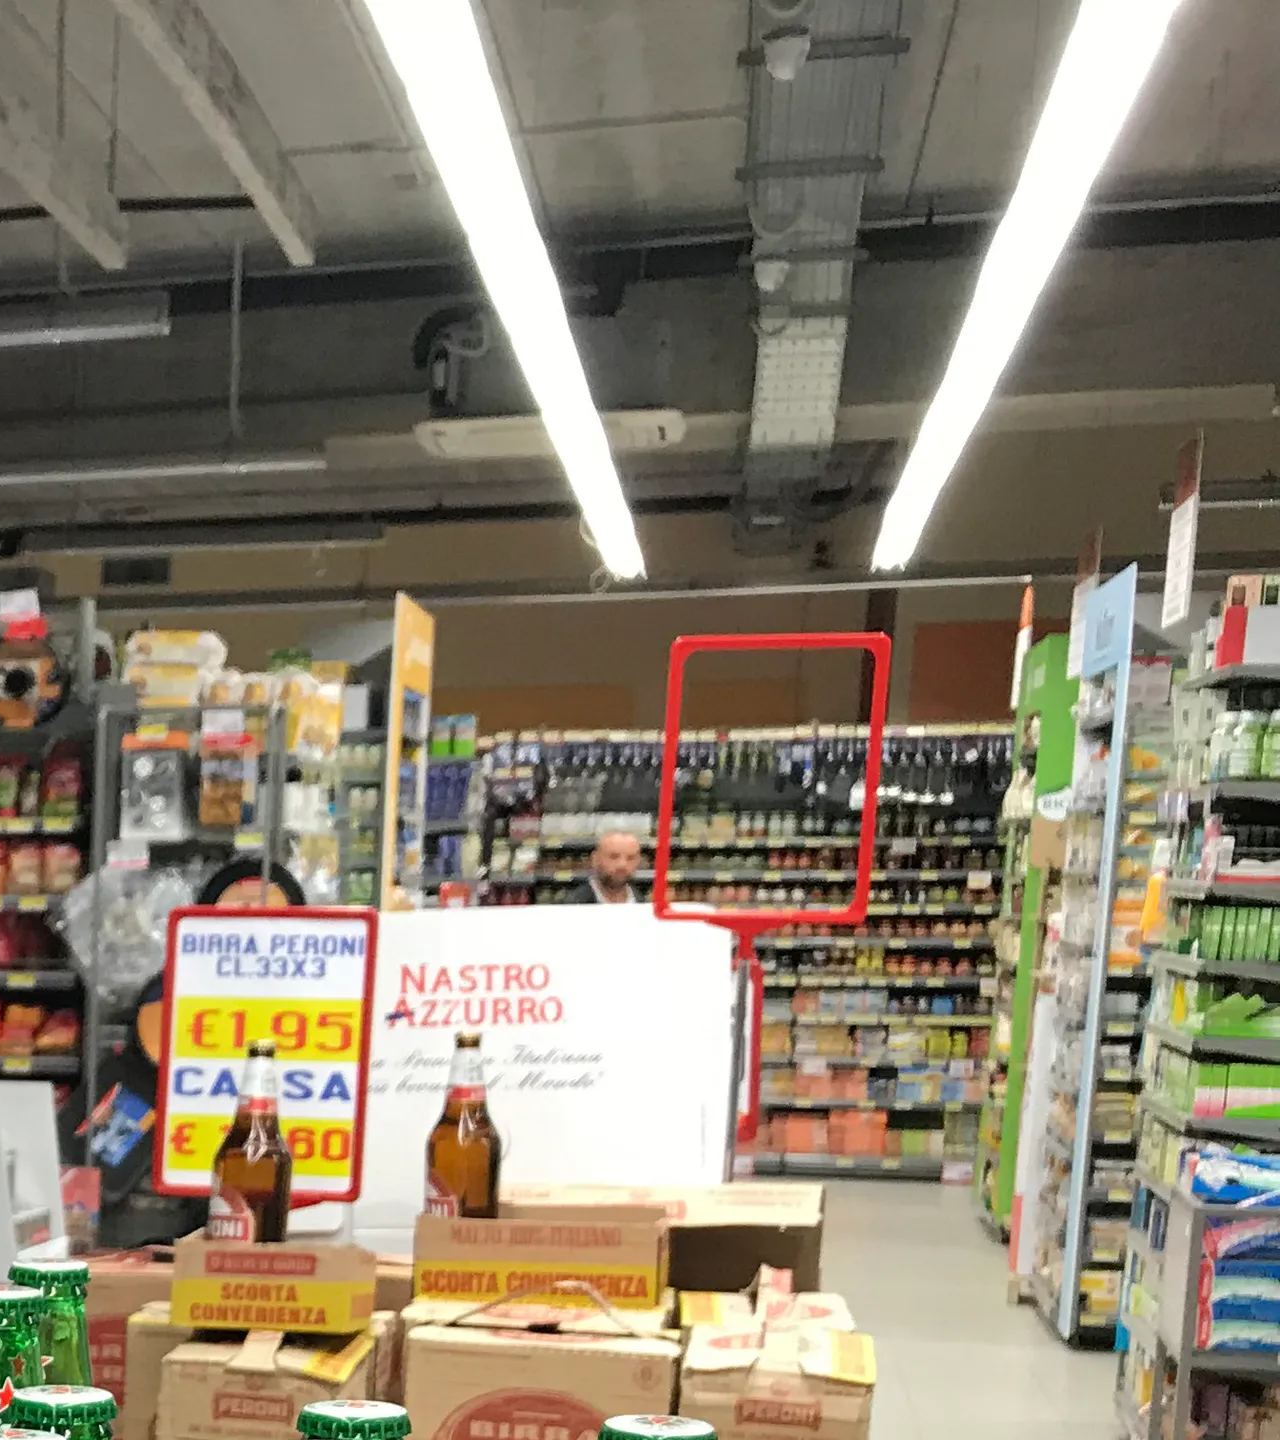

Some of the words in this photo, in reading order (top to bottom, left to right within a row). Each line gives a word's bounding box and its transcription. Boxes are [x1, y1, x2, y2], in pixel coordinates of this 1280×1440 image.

[181, 932, 258, 956] BIRRA
[269, 933, 366, 957] PERONI
[400, 962, 551, 995] NASTRO
[386, 995, 564, 1029] AZZURRO
[173, 1067, 352, 1101] CASA
[220, 1283, 298, 1303] SCORTA
[420, 1270, 499, 1296] SCORTA
[189, 1303, 328, 1326] CONVENIENZA
